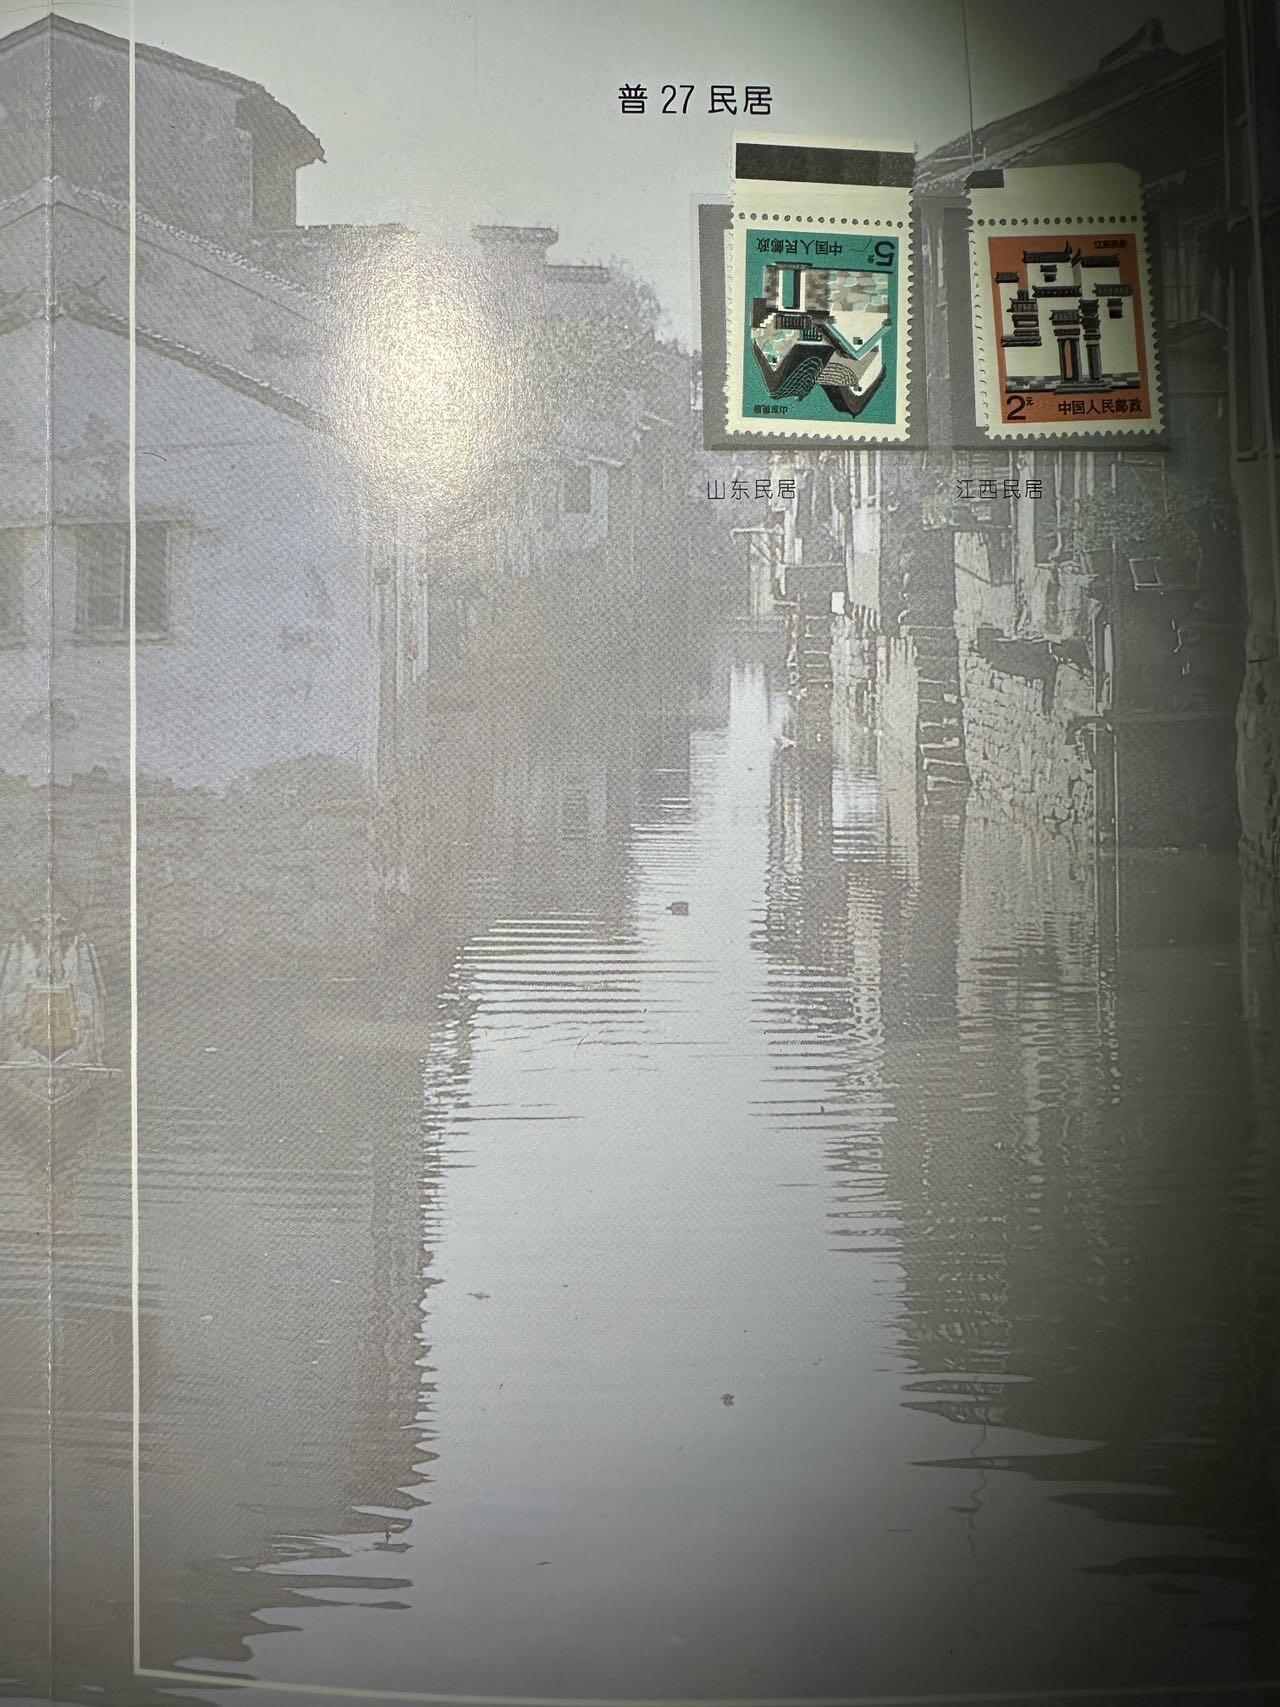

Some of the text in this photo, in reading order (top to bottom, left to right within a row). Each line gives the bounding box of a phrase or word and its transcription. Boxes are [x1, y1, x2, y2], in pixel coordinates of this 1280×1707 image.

[618, 83, 773, 115] 普 27 民居
[1058, 398, 1143, 415] 中国人民邮政
[707, 479, 796, 500] 山东民居
[956, 479, 1043, 499] 江西民居
